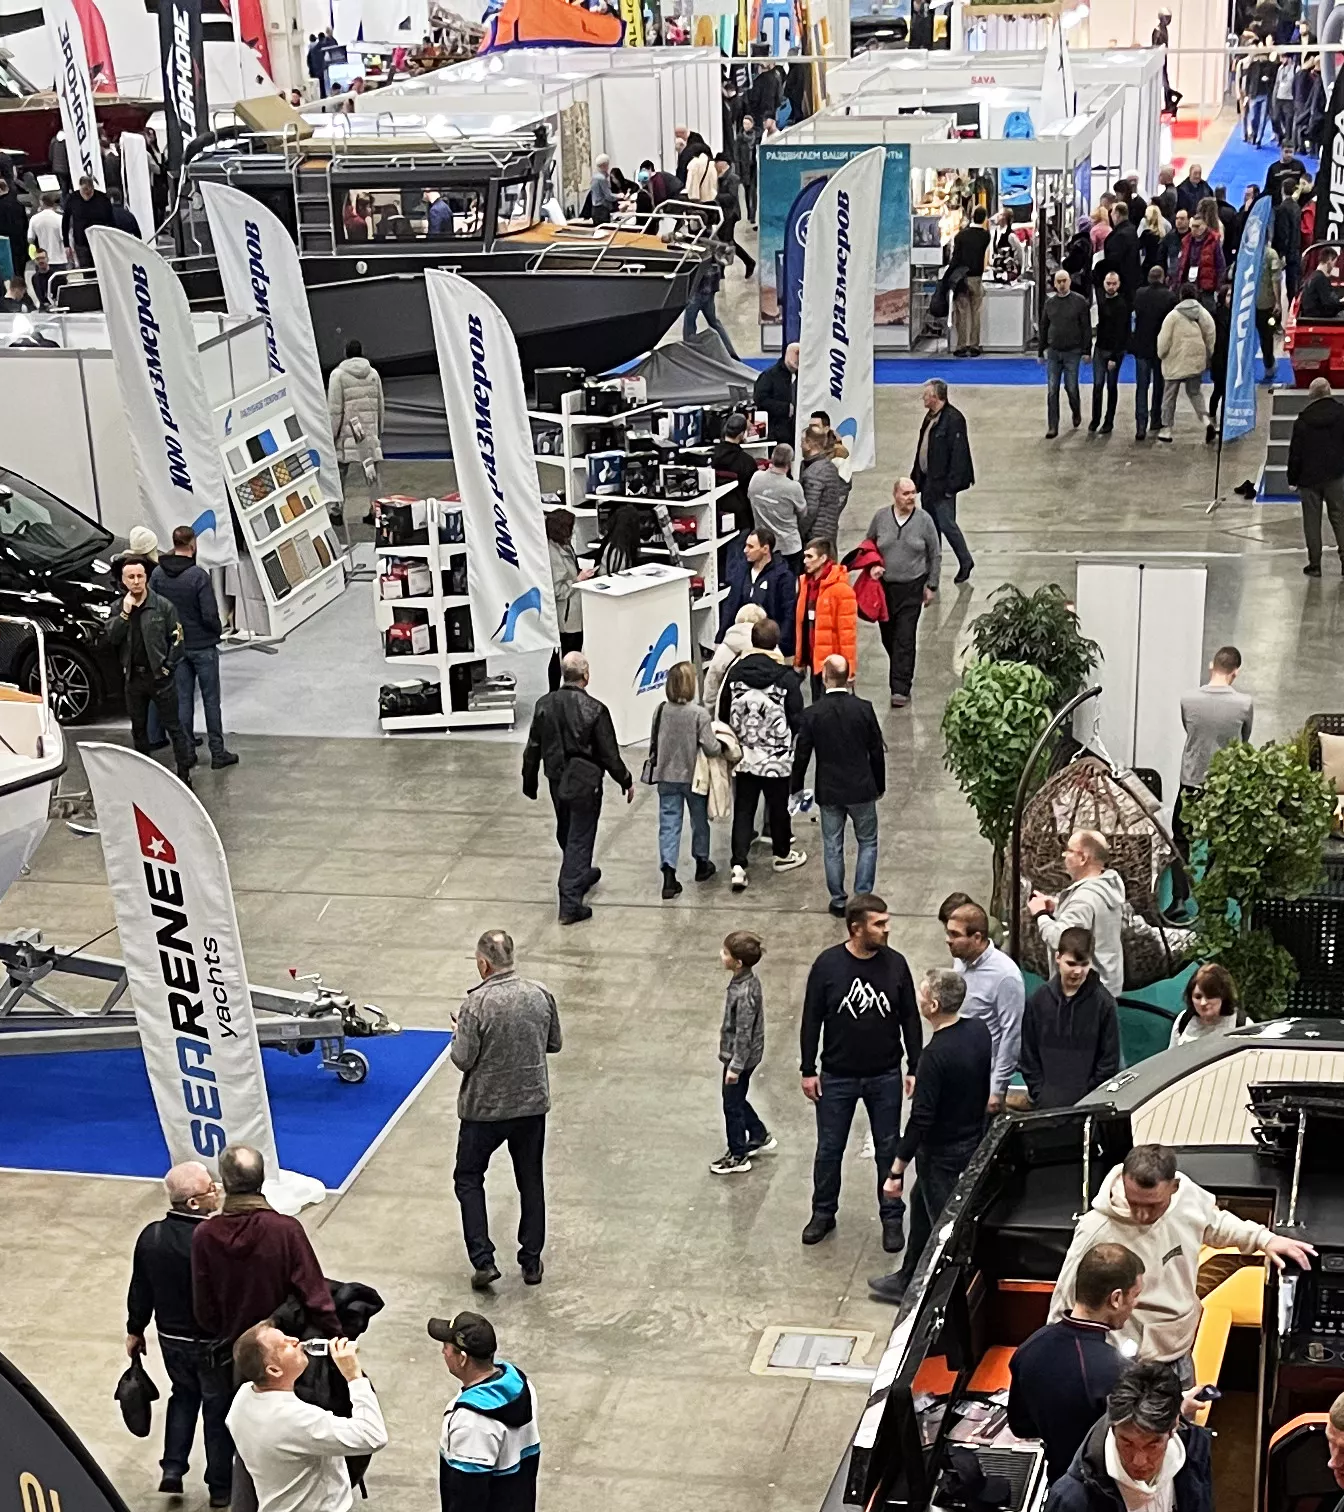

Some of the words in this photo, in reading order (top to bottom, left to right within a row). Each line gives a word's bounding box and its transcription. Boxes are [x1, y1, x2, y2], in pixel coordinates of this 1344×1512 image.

[171, 4, 197, 151] LBAKORE
[833, 189, 851, 346] размеров
[131, 263, 179, 432] размеров
[467, 313, 506, 501] размеров
[828, 346, 847, 402] 1000
[165, 434, 194, 496] 1000
[493, 502, 522, 568] 1000
[143, 861, 227, 1159] SEARENE
[204, 936, 237, 1041] yachts
